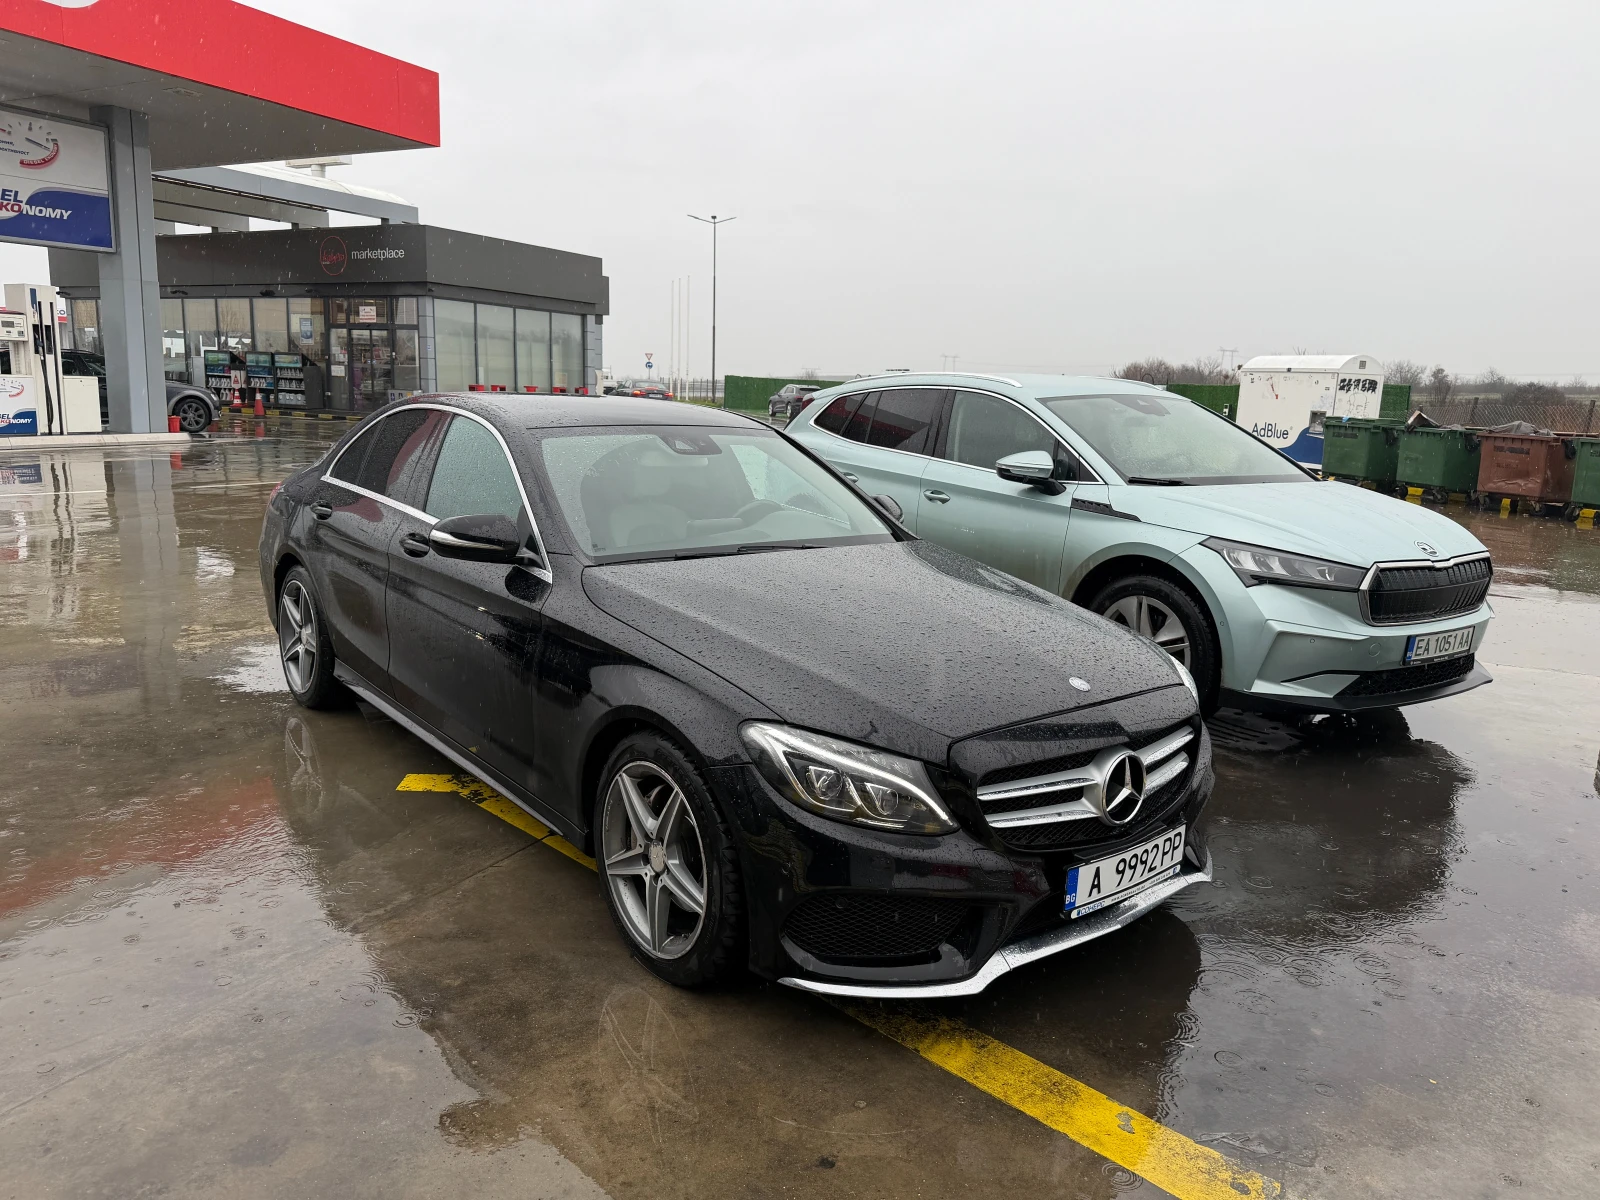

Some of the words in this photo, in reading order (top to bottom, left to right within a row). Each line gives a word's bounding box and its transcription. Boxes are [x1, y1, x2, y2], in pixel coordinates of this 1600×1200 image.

[351, 247, 405, 261] marketplace
[1251, 421, 1289, 440] AdBlue
[1415, 637, 1431, 657] EA
[1087, 865, 1102, 898] A
[1065, 892, 1076, 905] BG
